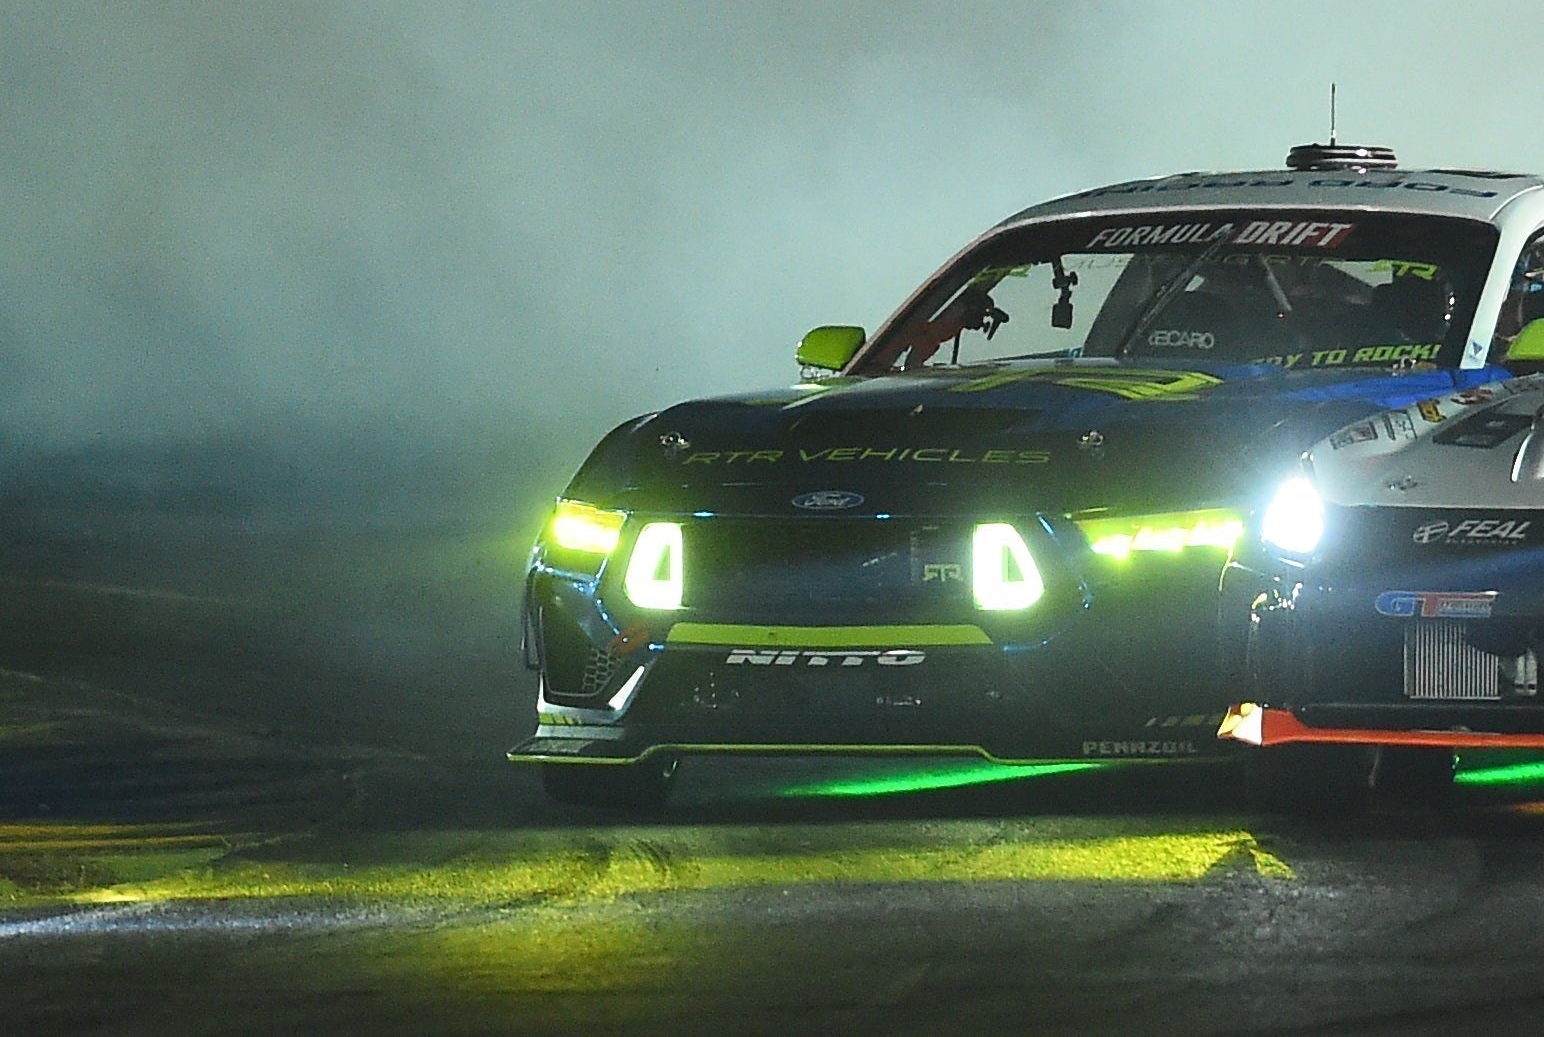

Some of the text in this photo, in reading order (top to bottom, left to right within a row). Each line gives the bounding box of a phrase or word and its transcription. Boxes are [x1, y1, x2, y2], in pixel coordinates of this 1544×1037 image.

[1086, 220, 1354, 249] FORMULA DRIFT
[1311, 349, 1348, 366] TO
[1352, 343, 1442, 363] ROCK!
[683, 446, 1054, 466] RTR VEHICLES
[1447, 519, 1532, 539] FEAL
[725, 648, 927, 667] NITTO
